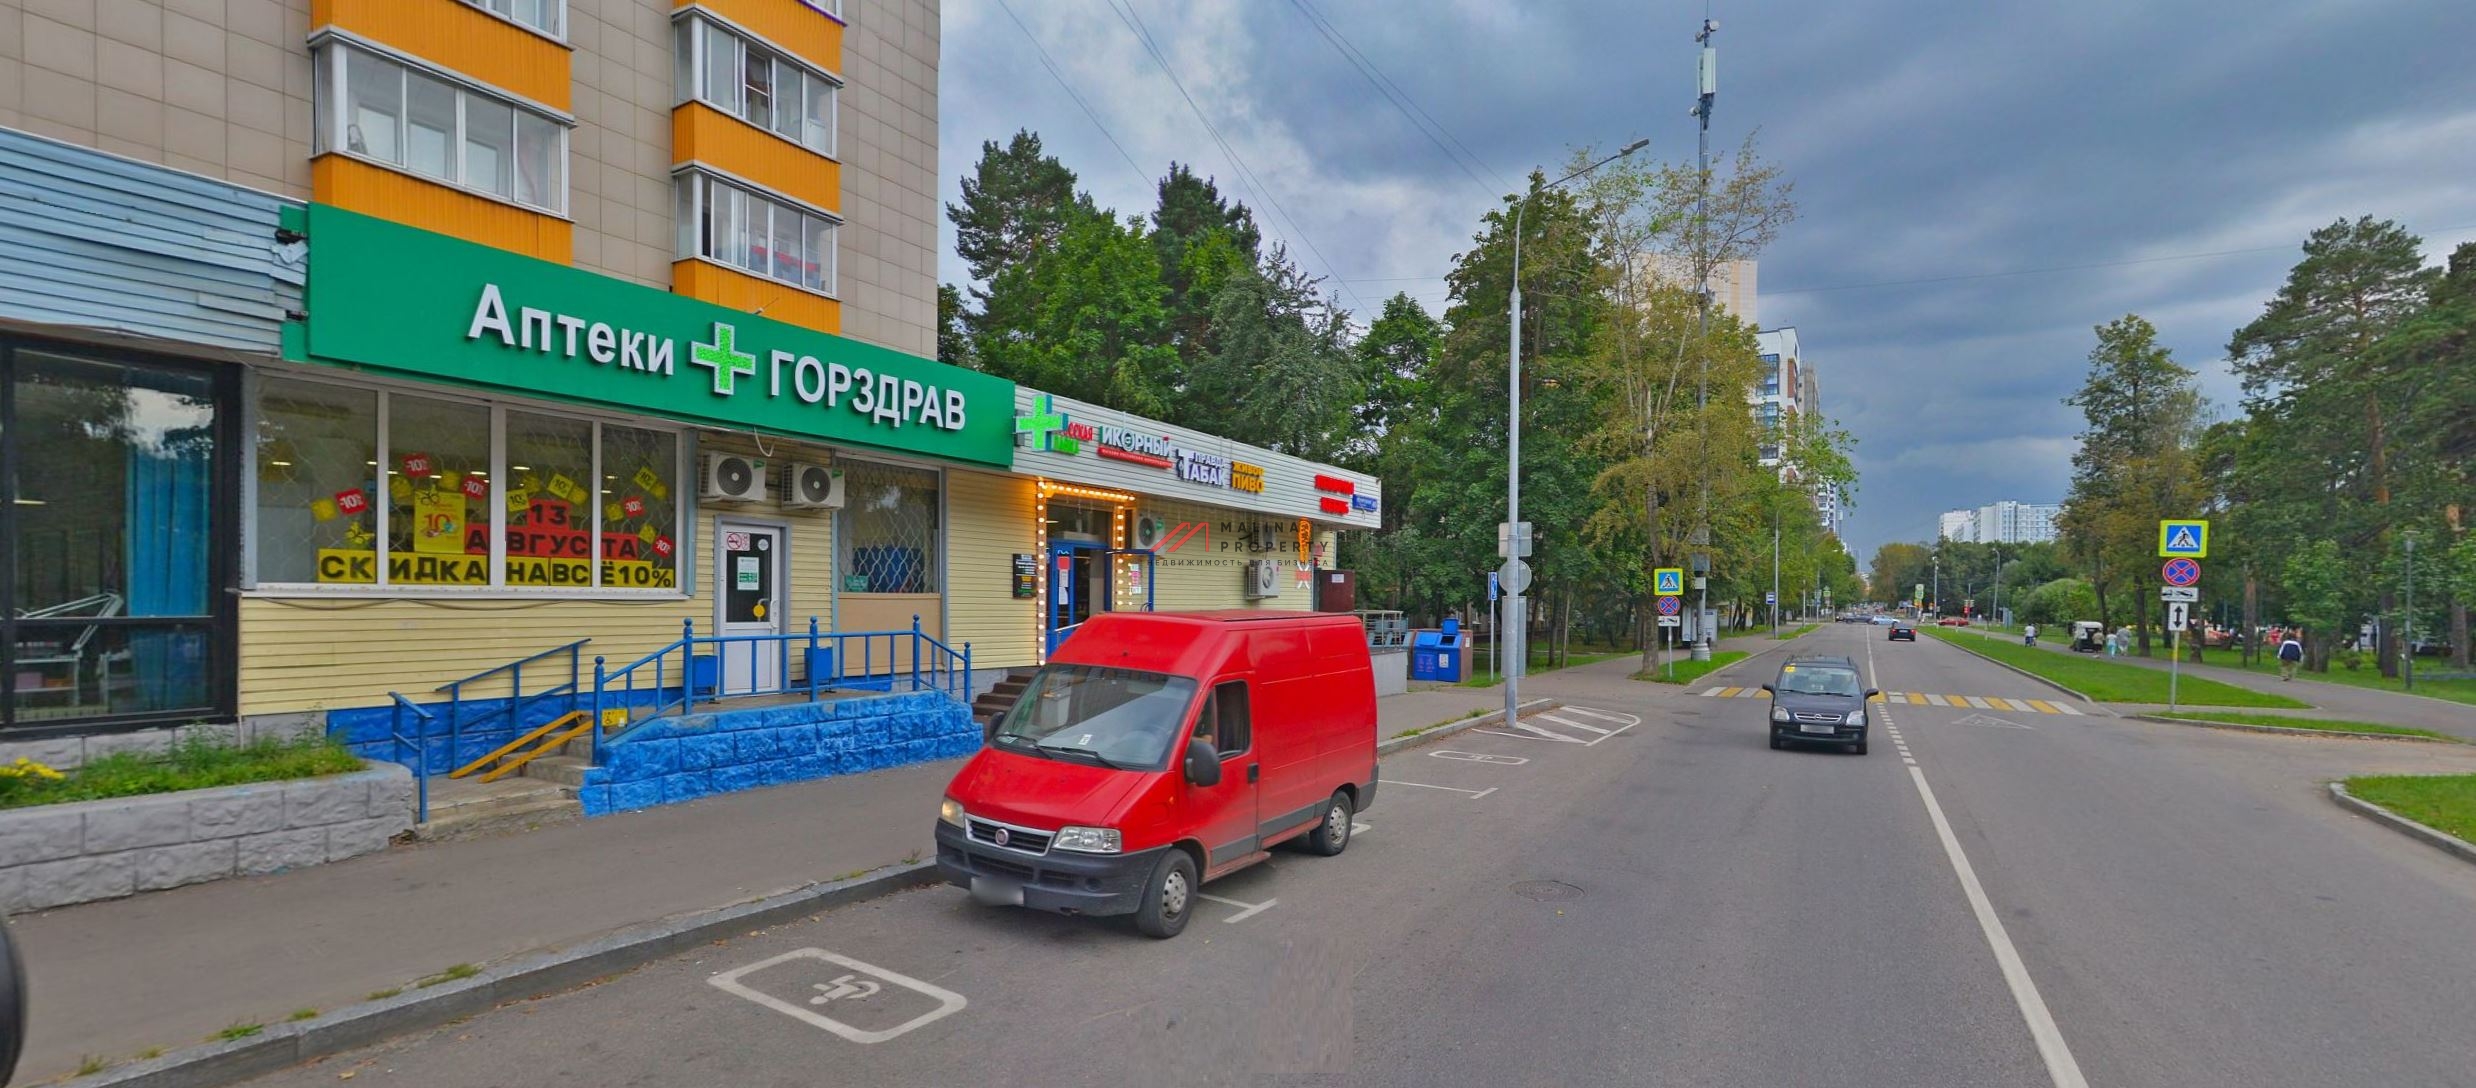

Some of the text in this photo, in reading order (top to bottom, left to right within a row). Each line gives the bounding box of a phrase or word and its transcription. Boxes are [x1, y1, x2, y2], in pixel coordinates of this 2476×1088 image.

[468, 283, 966, 430] Аптеки ГОРЗДРАВ
[1100, 426, 1169, 458] ИКОРНЫЙ
[1179, 450, 1227, 487] ТАБАК
[1232, 473, 1265, 493] ПИВО
[531, 504, 568, 525] 13
[466, 529, 637, 558] АВГУСТА
[321, 555, 487, 582] СКИДКА
